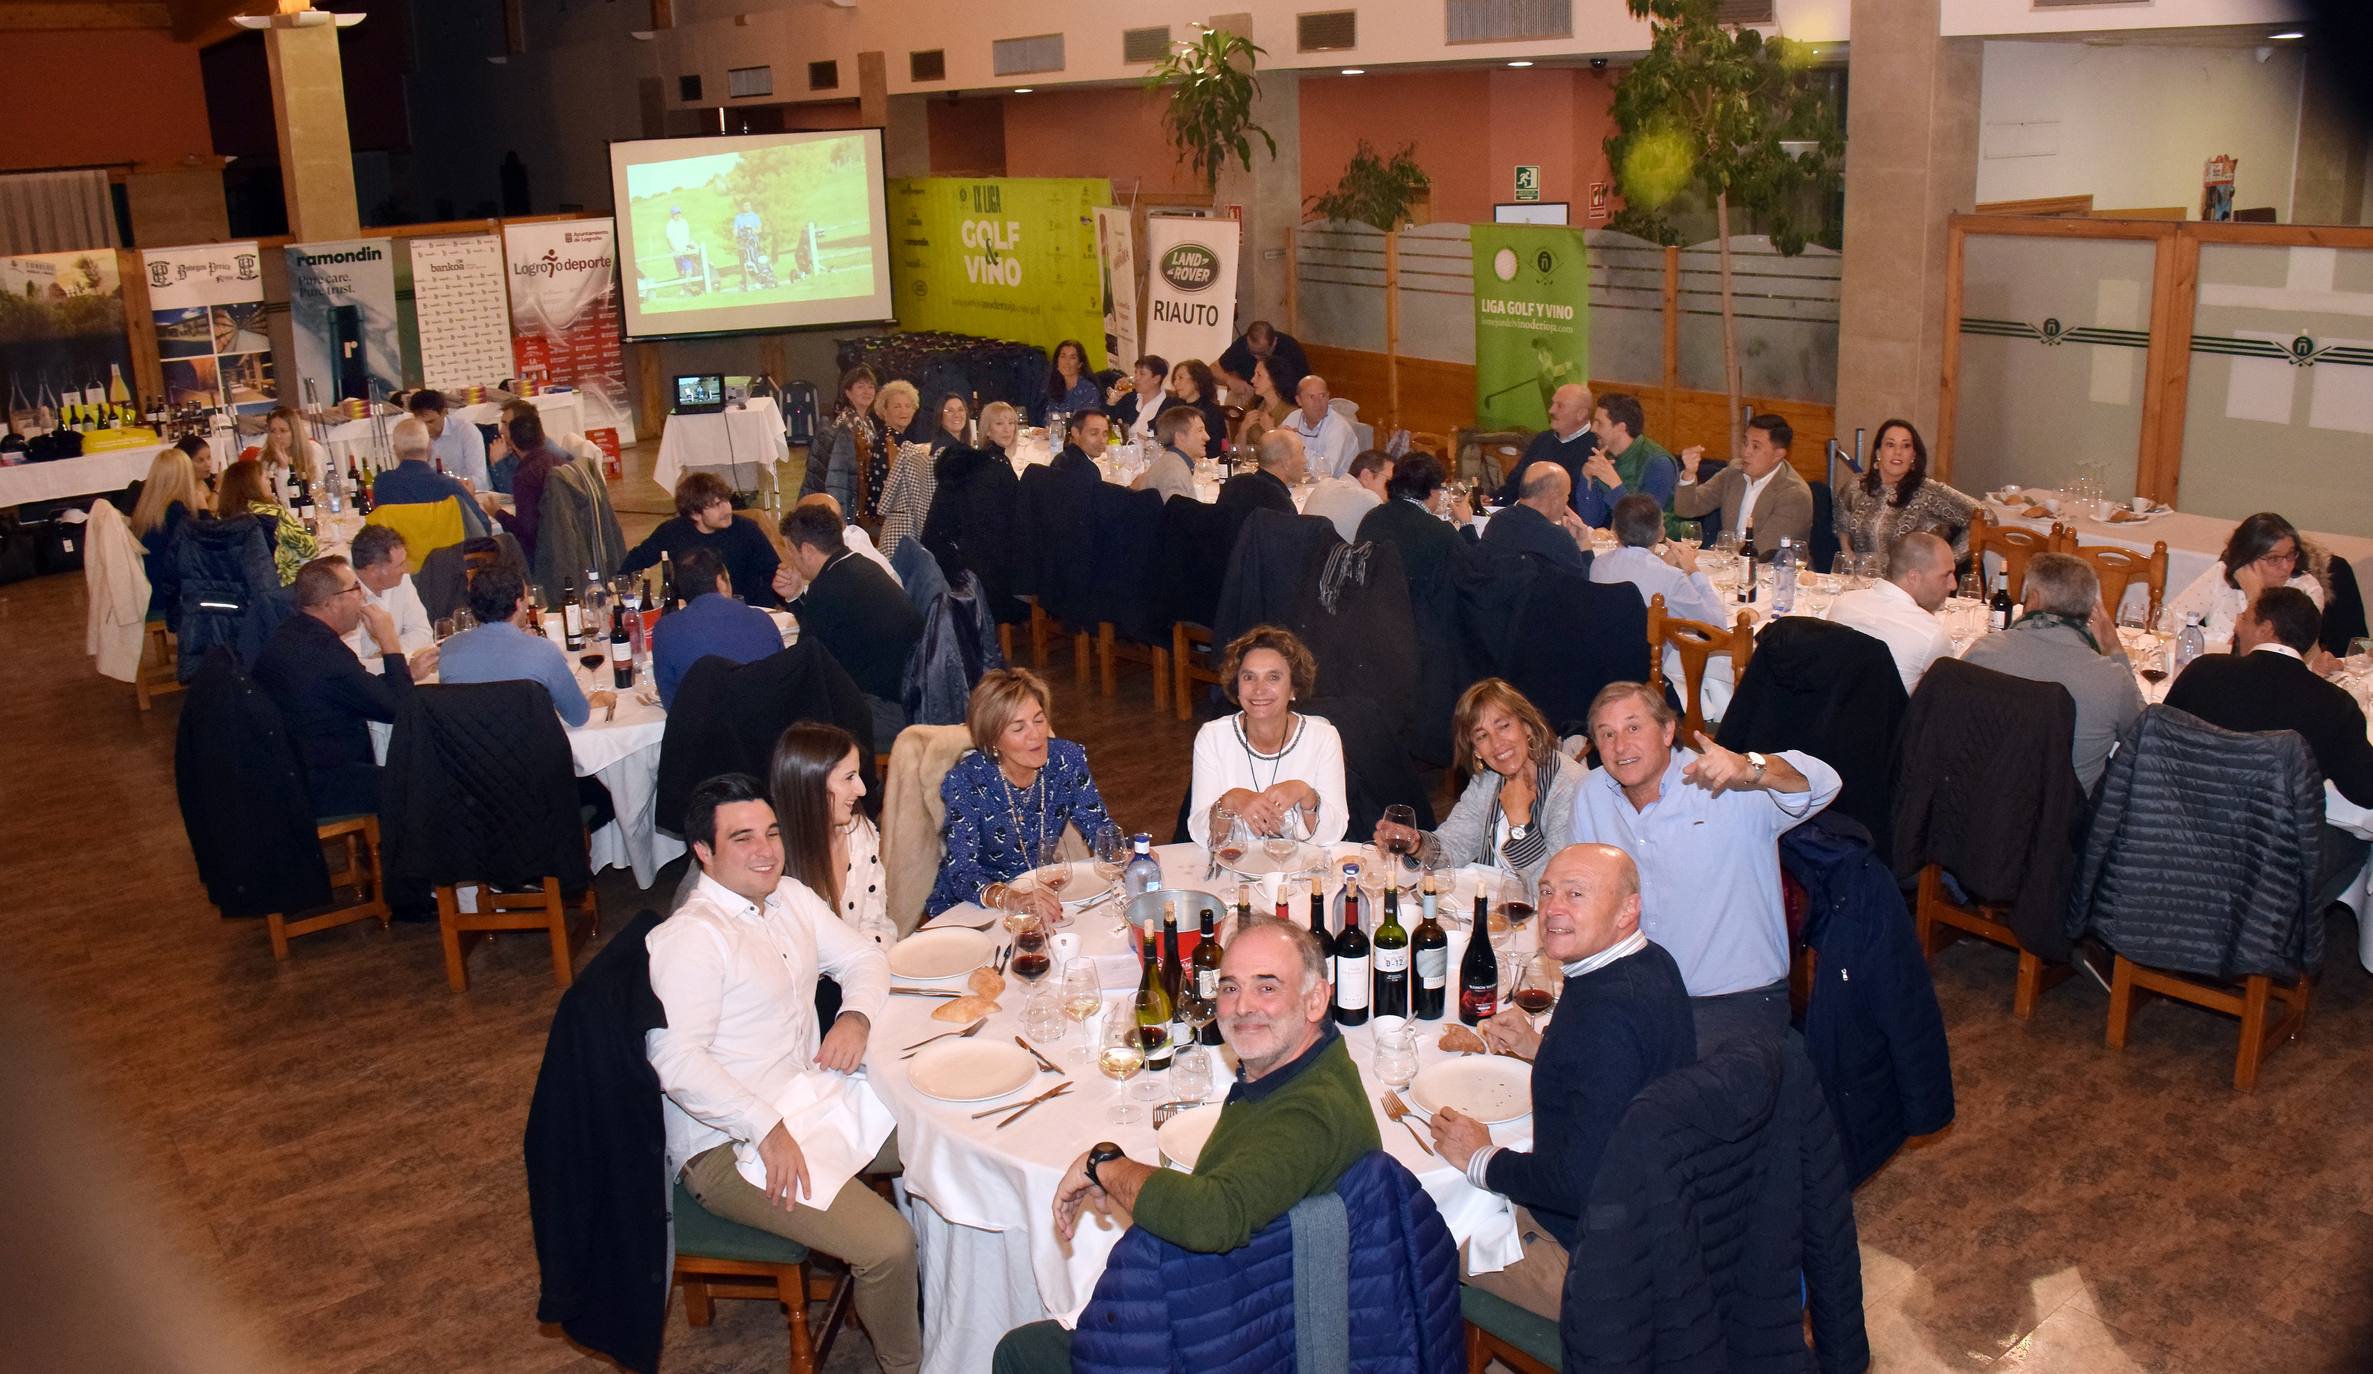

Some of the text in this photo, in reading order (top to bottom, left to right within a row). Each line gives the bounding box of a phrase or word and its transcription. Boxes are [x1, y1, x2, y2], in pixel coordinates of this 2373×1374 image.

[984, 185, 1001, 213] LIGA
[962, 220, 1020, 250] GOLF
[297, 246, 382, 267] ramondin
[986, 238, 998, 266] &
[1172, 252, 1203, 267] LAND
[431, 262, 465, 273] bankoa
[964, 255, 1022, 288] VINO
[1174, 267, 1210, 282] ROVER
[299, 273, 352, 286] Pure care.
[300, 284, 355, 298] Pure trust.
[1154, 300, 1219, 327] RIAUTO
[1481, 298, 1574, 320] LIGA GOLF Y VINO
